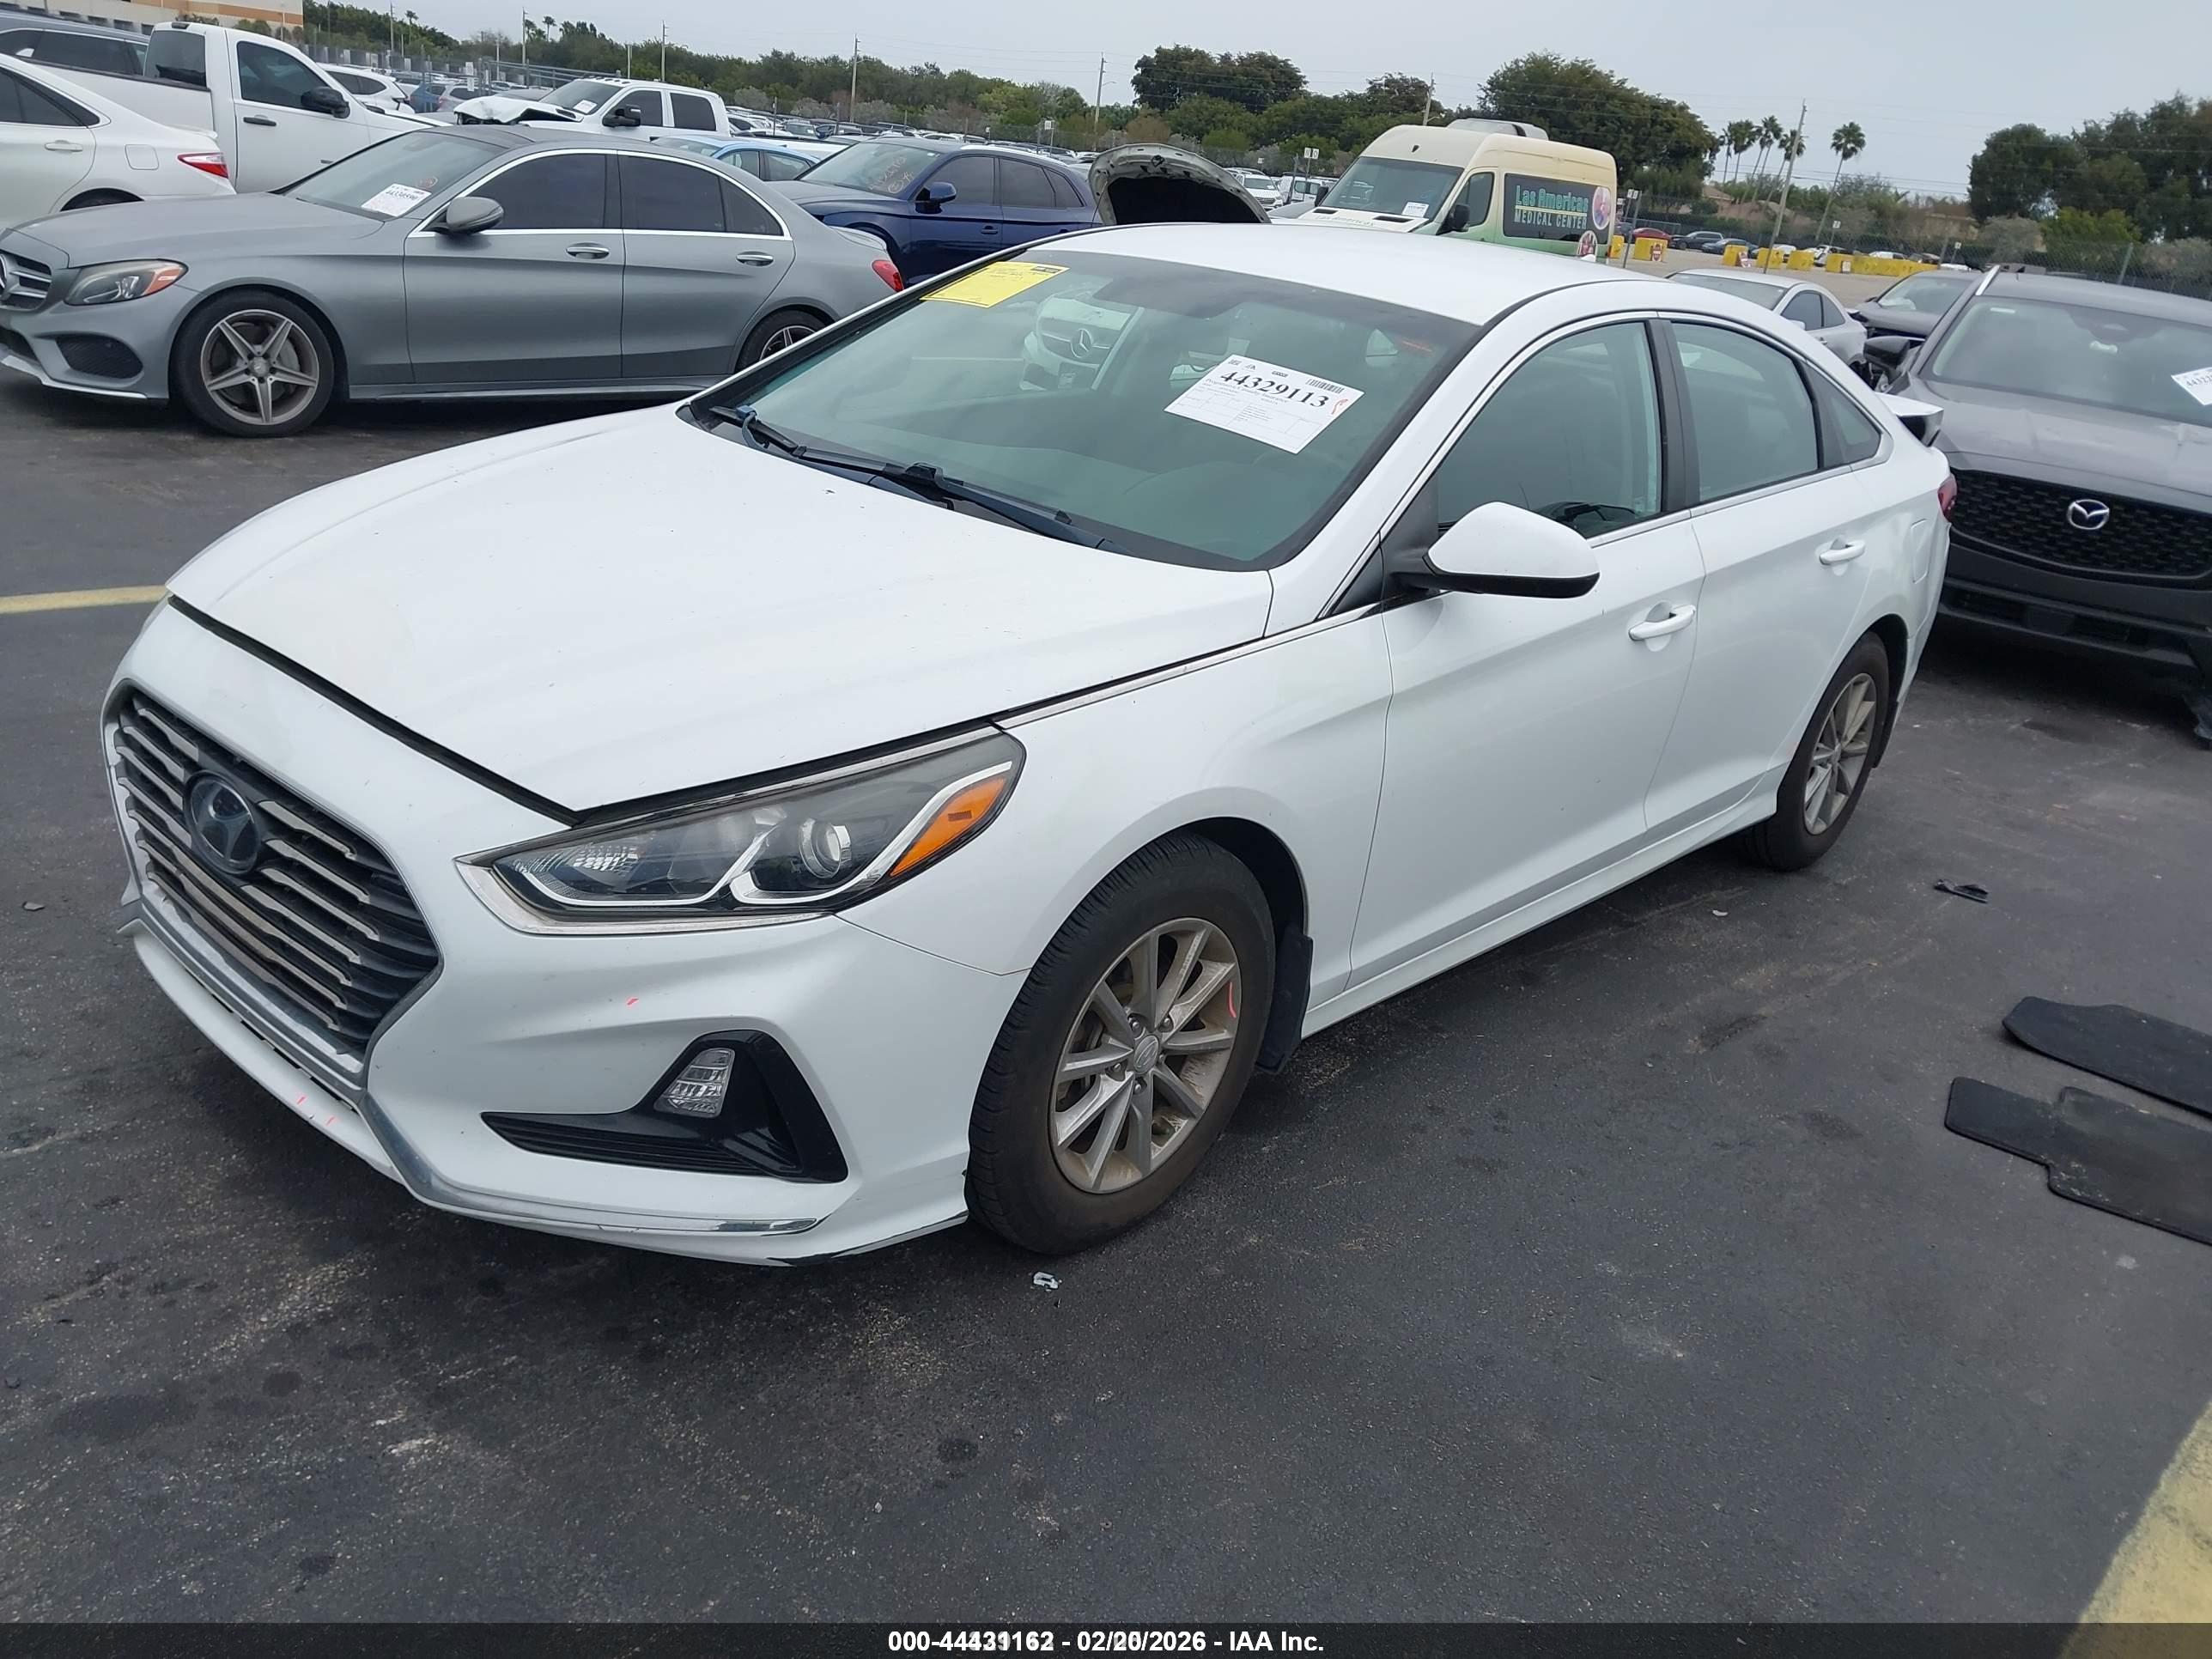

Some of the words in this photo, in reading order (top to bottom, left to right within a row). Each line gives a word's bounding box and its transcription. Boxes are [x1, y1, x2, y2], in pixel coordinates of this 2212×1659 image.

[1515, 185, 1536, 207] Las
[1538, 188, 1589, 212] Americas
[1514, 209, 1553, 227] MEDICAL
[1556, 214, 1588, 229] CENTER
[1220, 372, 1330, 408] 44329113
